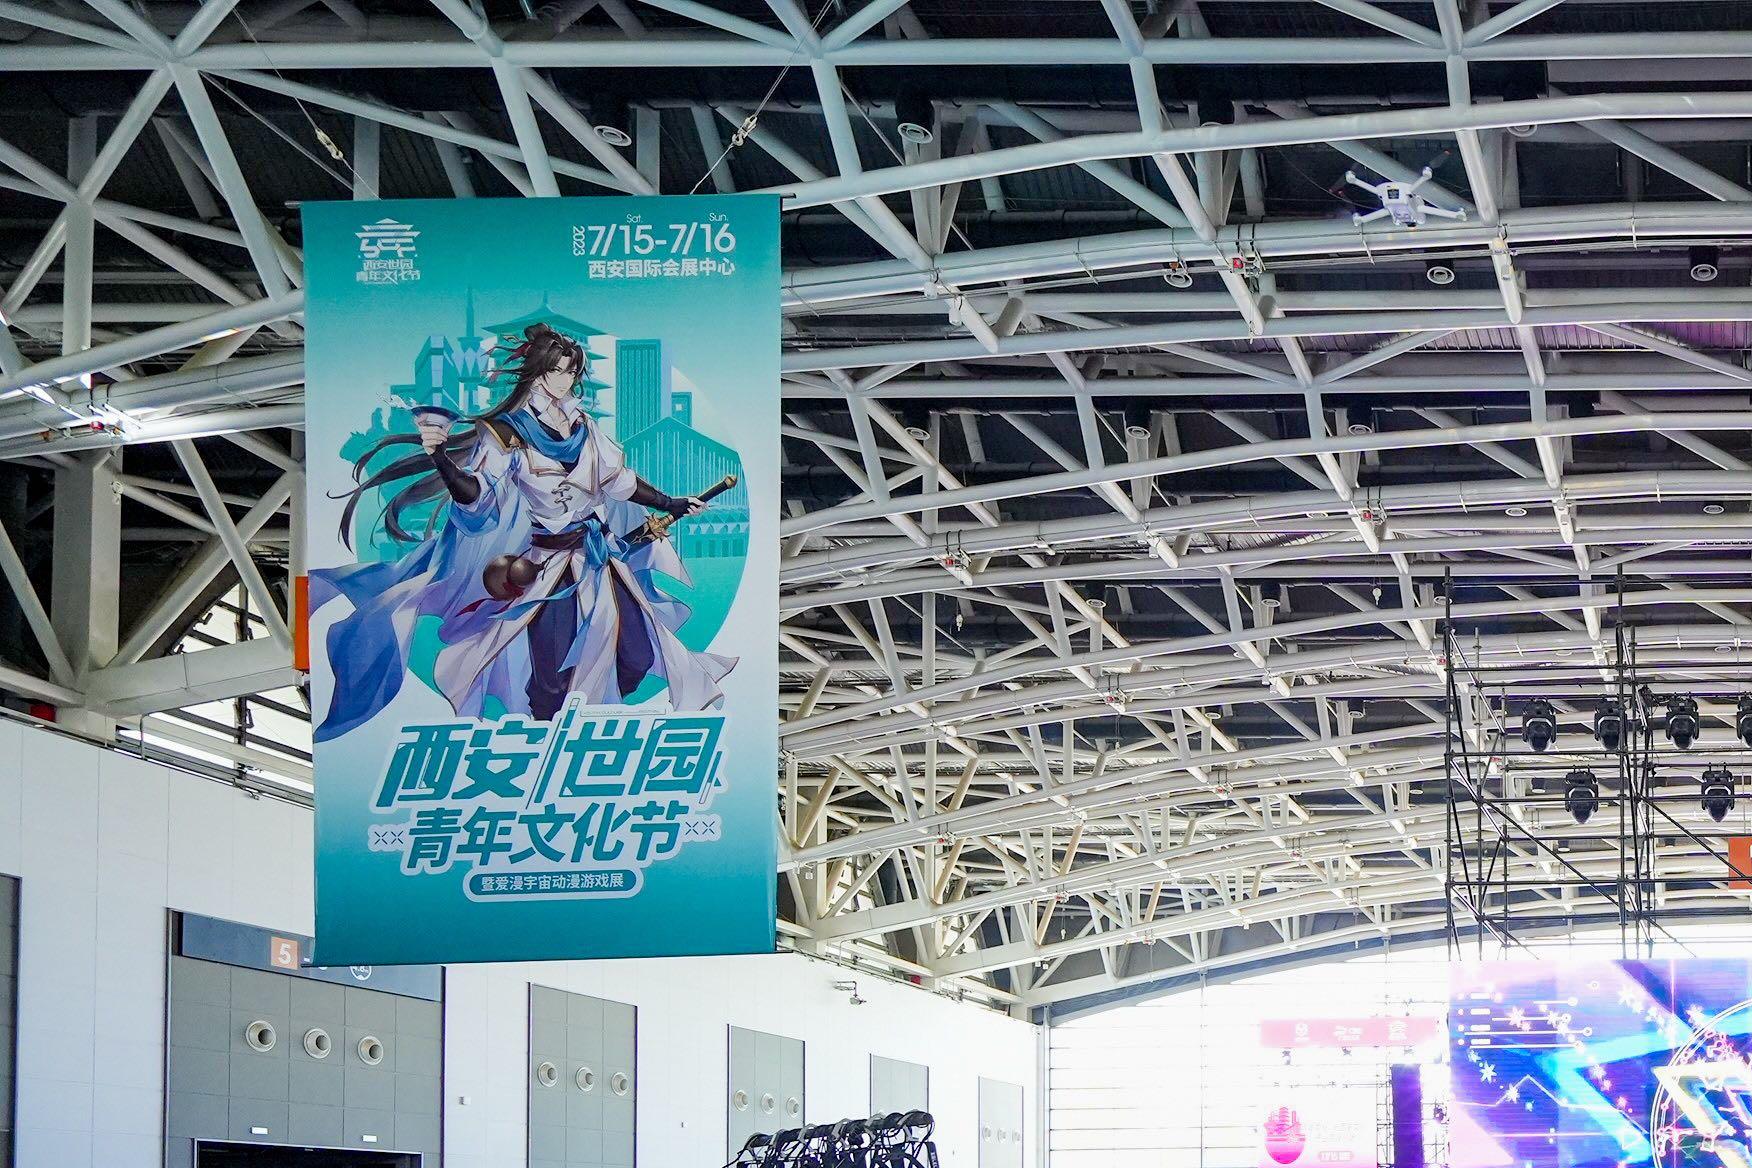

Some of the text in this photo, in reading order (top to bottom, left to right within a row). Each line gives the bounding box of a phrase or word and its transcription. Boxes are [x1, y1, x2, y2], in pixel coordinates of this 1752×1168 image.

[573, 226, 585, 257] 2023
[587, 222, 736, 257] 7/15-7/16
[588, 257, 736, 279] 西安国际会展中心
[407, 801, 689, 868] 青年文化节
[481, 874, 623, 891] 暨爱漫宇宙动漫游戏展
[279, 943, 291, 965] 5
